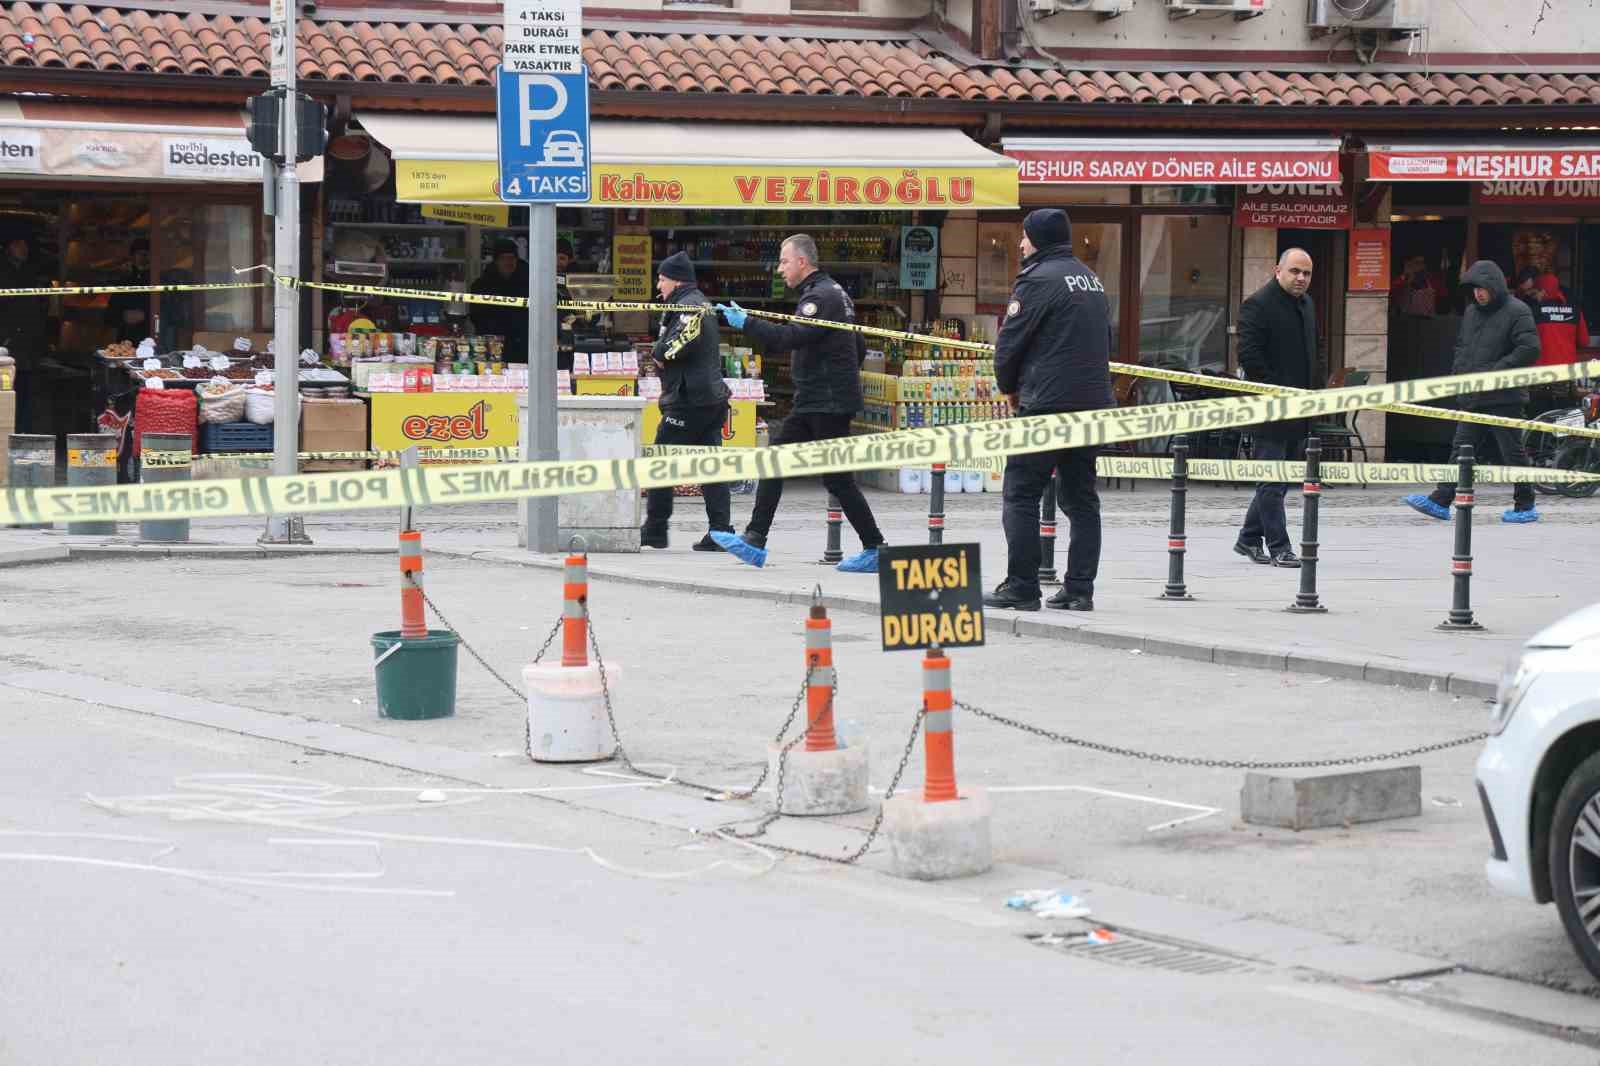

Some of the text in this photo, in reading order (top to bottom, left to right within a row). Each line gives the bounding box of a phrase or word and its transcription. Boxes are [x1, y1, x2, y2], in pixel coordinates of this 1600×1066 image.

[520, 11, 527, 20] 4
[523, 26, 568, 38] DURAĞI
[505, 43, 580, 55] PARK ETMEK
[514, 60, 572, 71] YASAKTIR
[518, 74, 569, 146] P
[0, 141, 33, 157] ten
[170, 144, 260, 167] bedesten
[1089, 160, 1146, 178] SARAY
[1152, 158, 1213, 178] DÖNER
[1219, 158, 1258, 178] AİLE
[1261, 160, 1332, 178] SALONU
[1456, 155, 1553, 179] MEŞHUR
[506, 170, 587, 195] 4 TAKSİ
[600, 172, 684, 203] Kahve
[734, 169, 976, 204] VEZİROĞLU
[1251, 212, 1276, 223] ÜST
[402, 399, 489, 441] ezel
[890, 550, 969, 591] TAKSİ
[883, 604, 982, 647] DURAĞI
